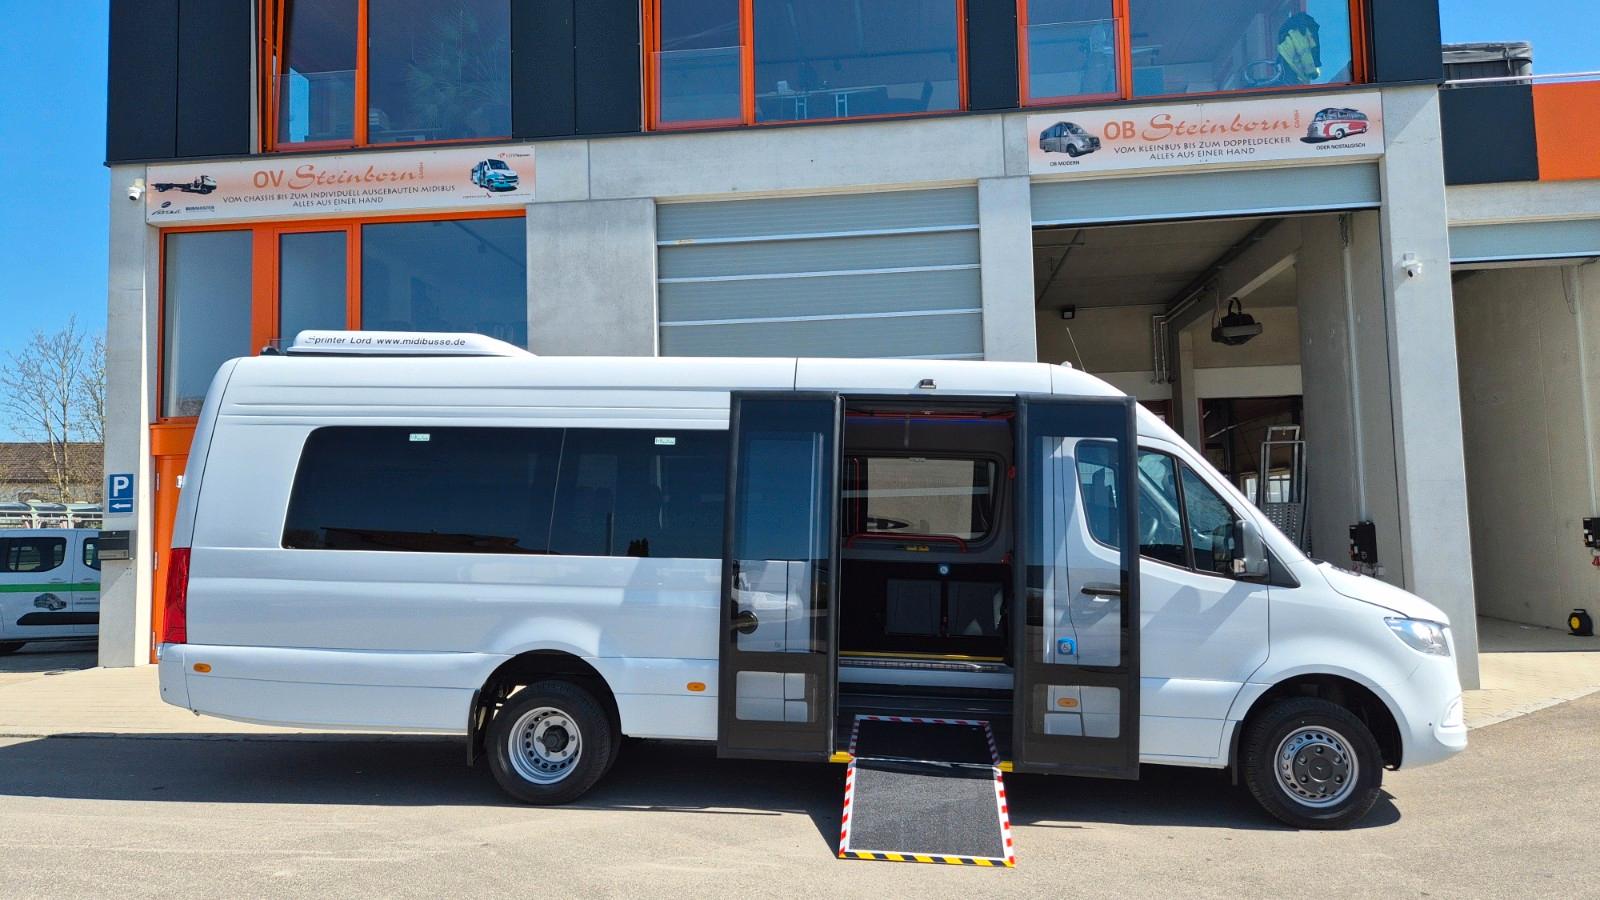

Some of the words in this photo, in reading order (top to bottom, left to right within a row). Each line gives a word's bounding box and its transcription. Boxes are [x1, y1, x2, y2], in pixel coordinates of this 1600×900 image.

[1103, 121, 1136, 140] OB
[1142, 113, 1290, 141] Steinborn
[1114, 146, 1136, 154] VOM
[1139, 143, 1181, 152] KLEINBUS
[1184, 142, 1196, 150] BIS
[1199, 140, 1221, 149] ZUM
[1223, 137, 1290, 147] DOPPELDECKER
[1150, 152, 1175, 160] ALLES
[1177, 151, 1195, 159] AUS
[1197, 149, 1223, 157] EINER
[1226, 147, 1255, 156] HAND
[253, 170, 284, 189] OV
[287, 164, 416, 190] Steinborn
[223, 196, 242, 204] VOM
[243, 193, 275, 203] CHASSIS
[290, 192, 308, 200] ZUM
[310, 189, 360, 199] INDIVIDUELL
[362, 186, 419, 196] AUSGEBAUTEN
[421, 185, 456, 193] MIDIBUS
[293, 200, 314, 208] ALLES
[333, 197, 356, 206] EINER
[358, 196, 384, 204] HAND
[350, 337, 372, 345] Lord
[376, 337, 466, 346] www.midibusse.de
[113, 476, 130, 497] P
